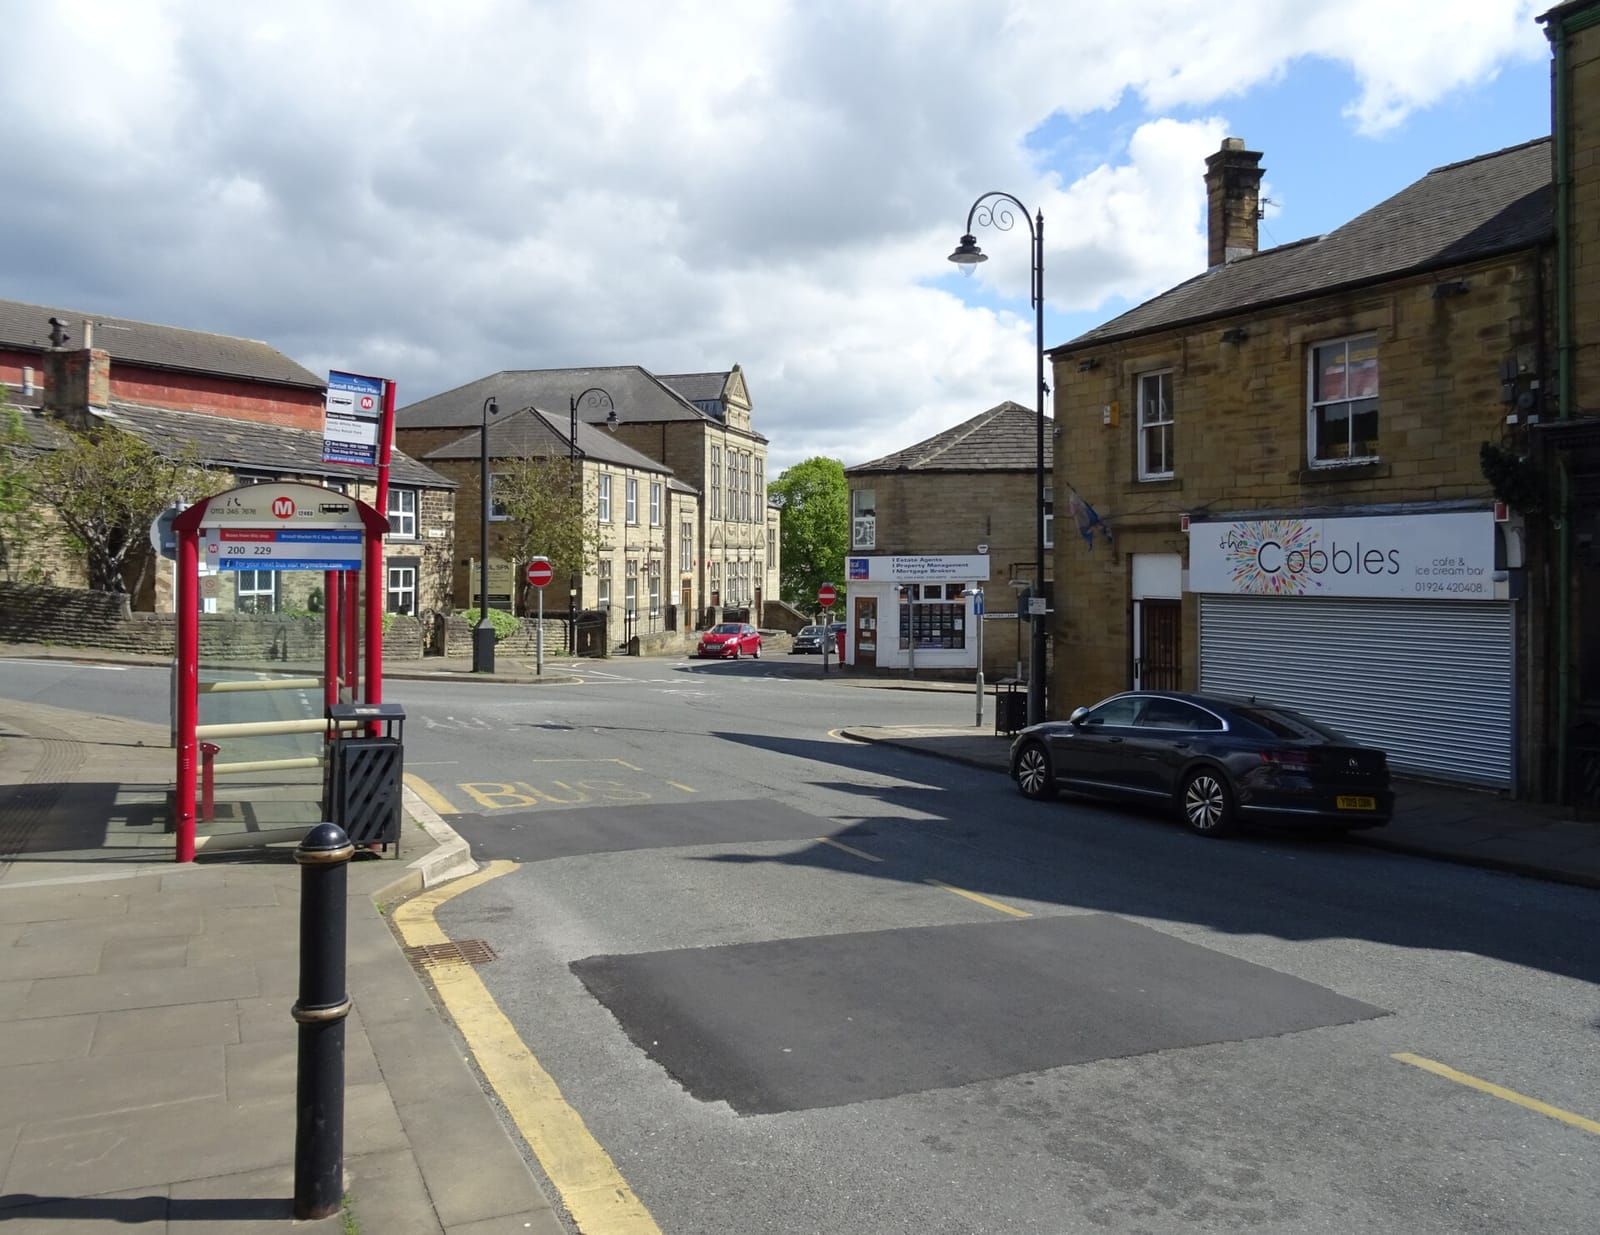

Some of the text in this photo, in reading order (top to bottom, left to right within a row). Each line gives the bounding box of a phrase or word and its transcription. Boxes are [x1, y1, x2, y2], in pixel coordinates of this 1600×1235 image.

[273, 499, 293, 516] M
[1219, 530, 1250, 552] the
[227, 546, 272, 555] 200 229
[1258, 541, 1400, 575] Cobbles
[1457, 557, 1465, 566] &
[1415, 566, 1485, 576] ice cream bar
[1415, 582, 1444, 592] 01924
[457, 780, 651, 810] BUS
